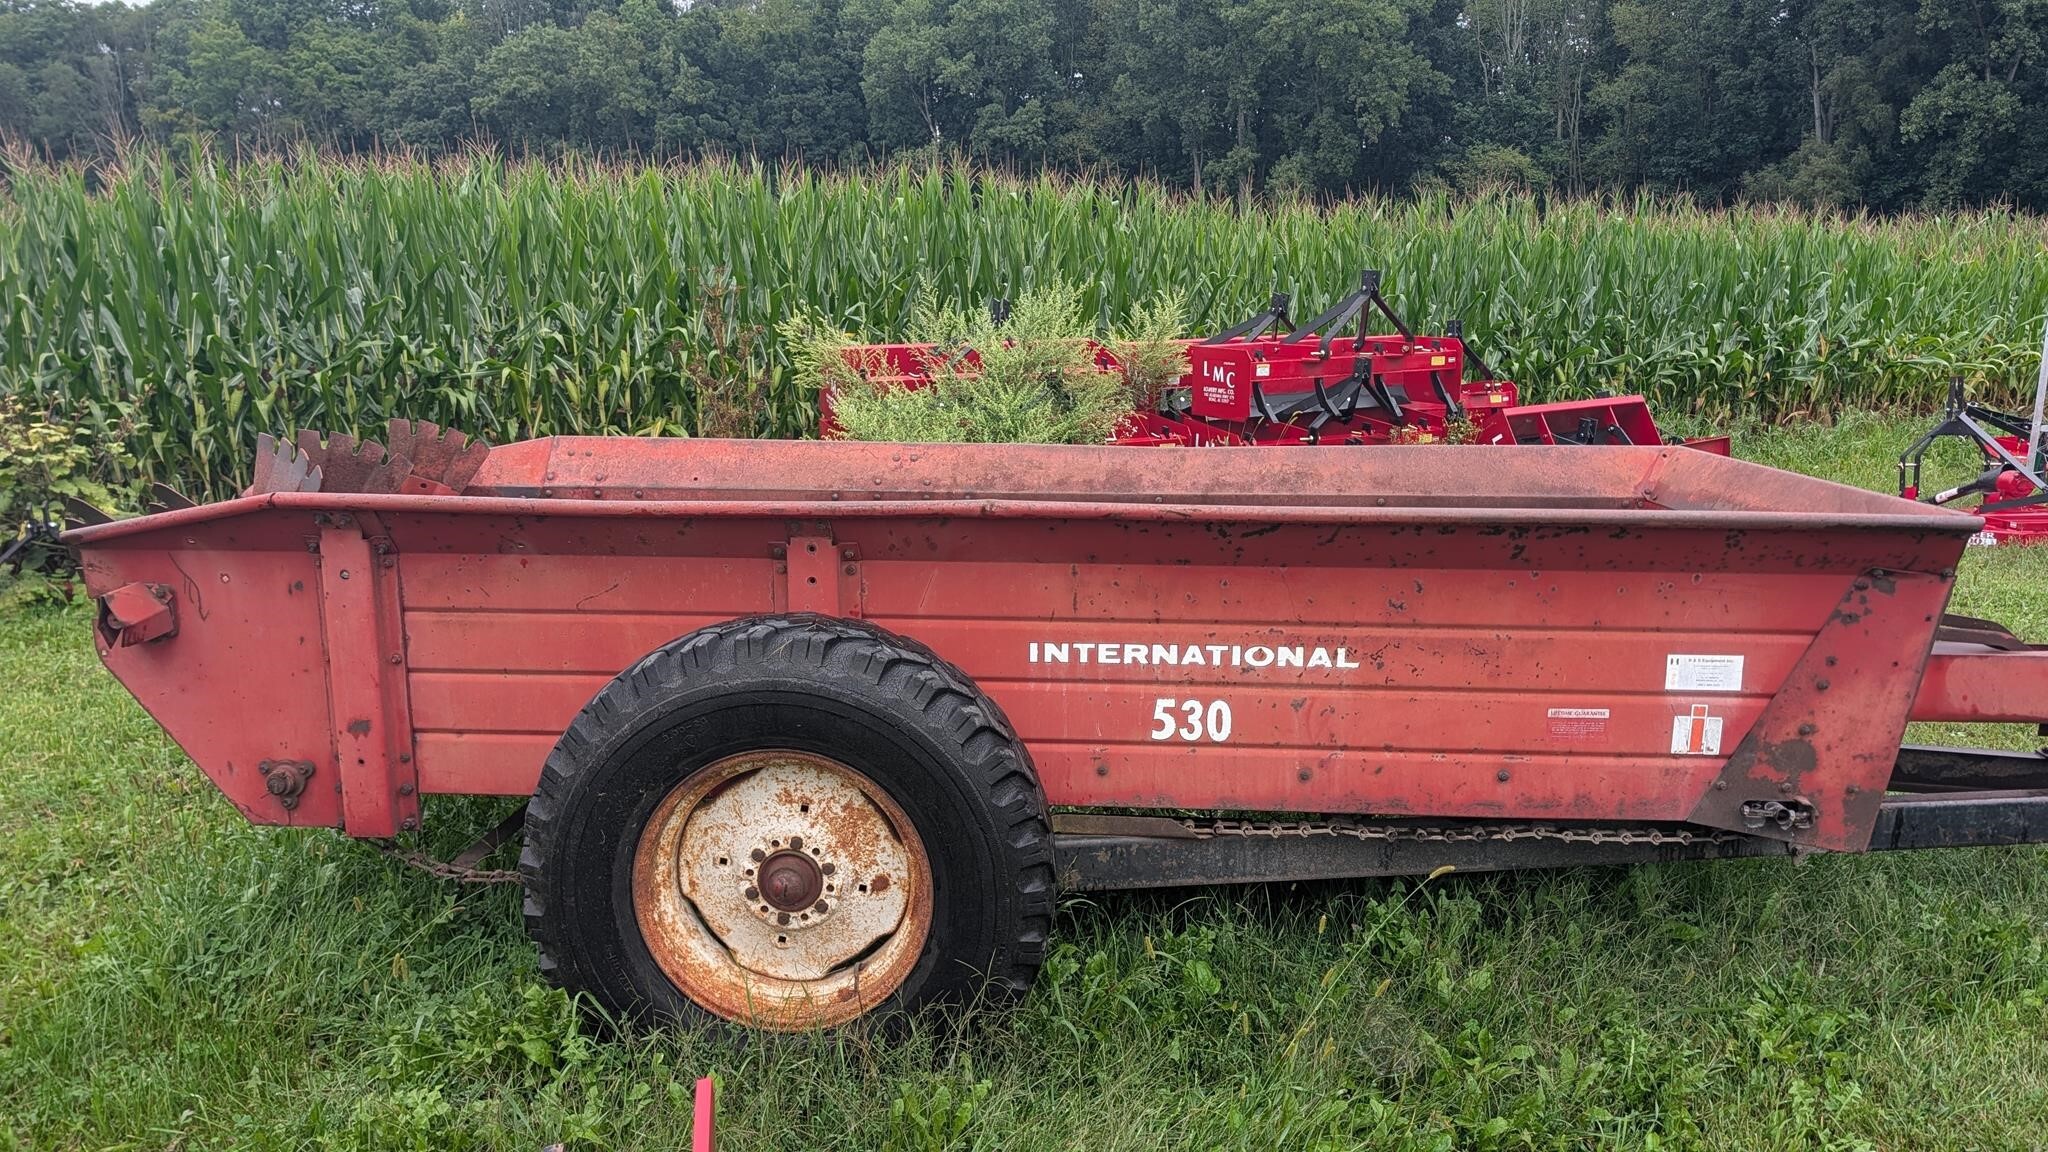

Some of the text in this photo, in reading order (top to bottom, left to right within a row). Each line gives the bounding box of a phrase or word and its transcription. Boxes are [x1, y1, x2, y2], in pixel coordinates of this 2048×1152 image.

[1203, 360, 1235, 388] LMC
[1029, 642, 1360, 669] INTERNATIONAL
[1151, 698, 1232, 742] 530
